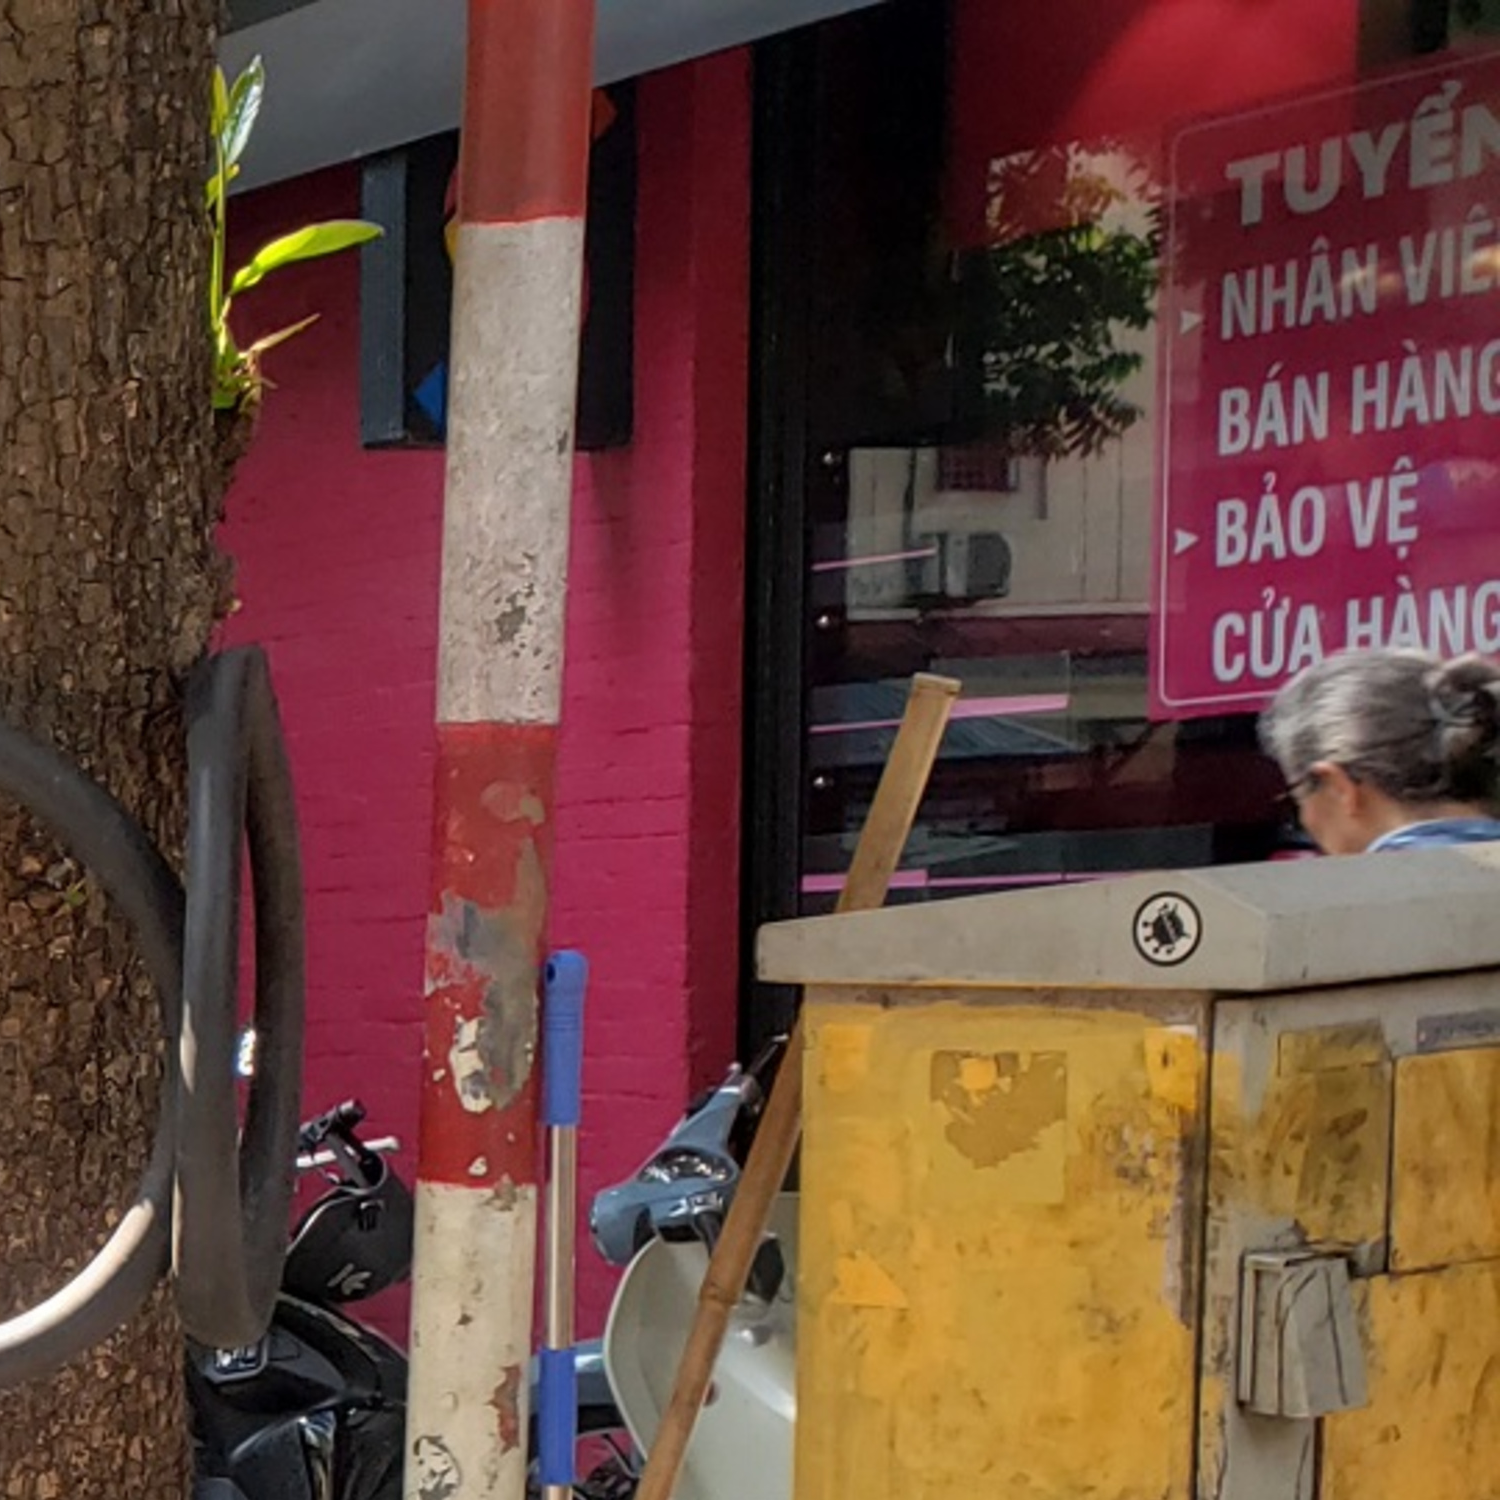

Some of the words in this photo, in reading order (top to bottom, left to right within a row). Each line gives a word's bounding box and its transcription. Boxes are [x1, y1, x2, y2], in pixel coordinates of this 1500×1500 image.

[1220, 235, 1378, 340] NHÂN
[1400, 204, 1500, 305] VIÊ
[1219, 362, 1328, 456] BÁN
[1215, 472, 1325, 568] BẢO
[1347, 457, 1419, 558] VỆ
[1212, 586, 1324, 682] CỬA
